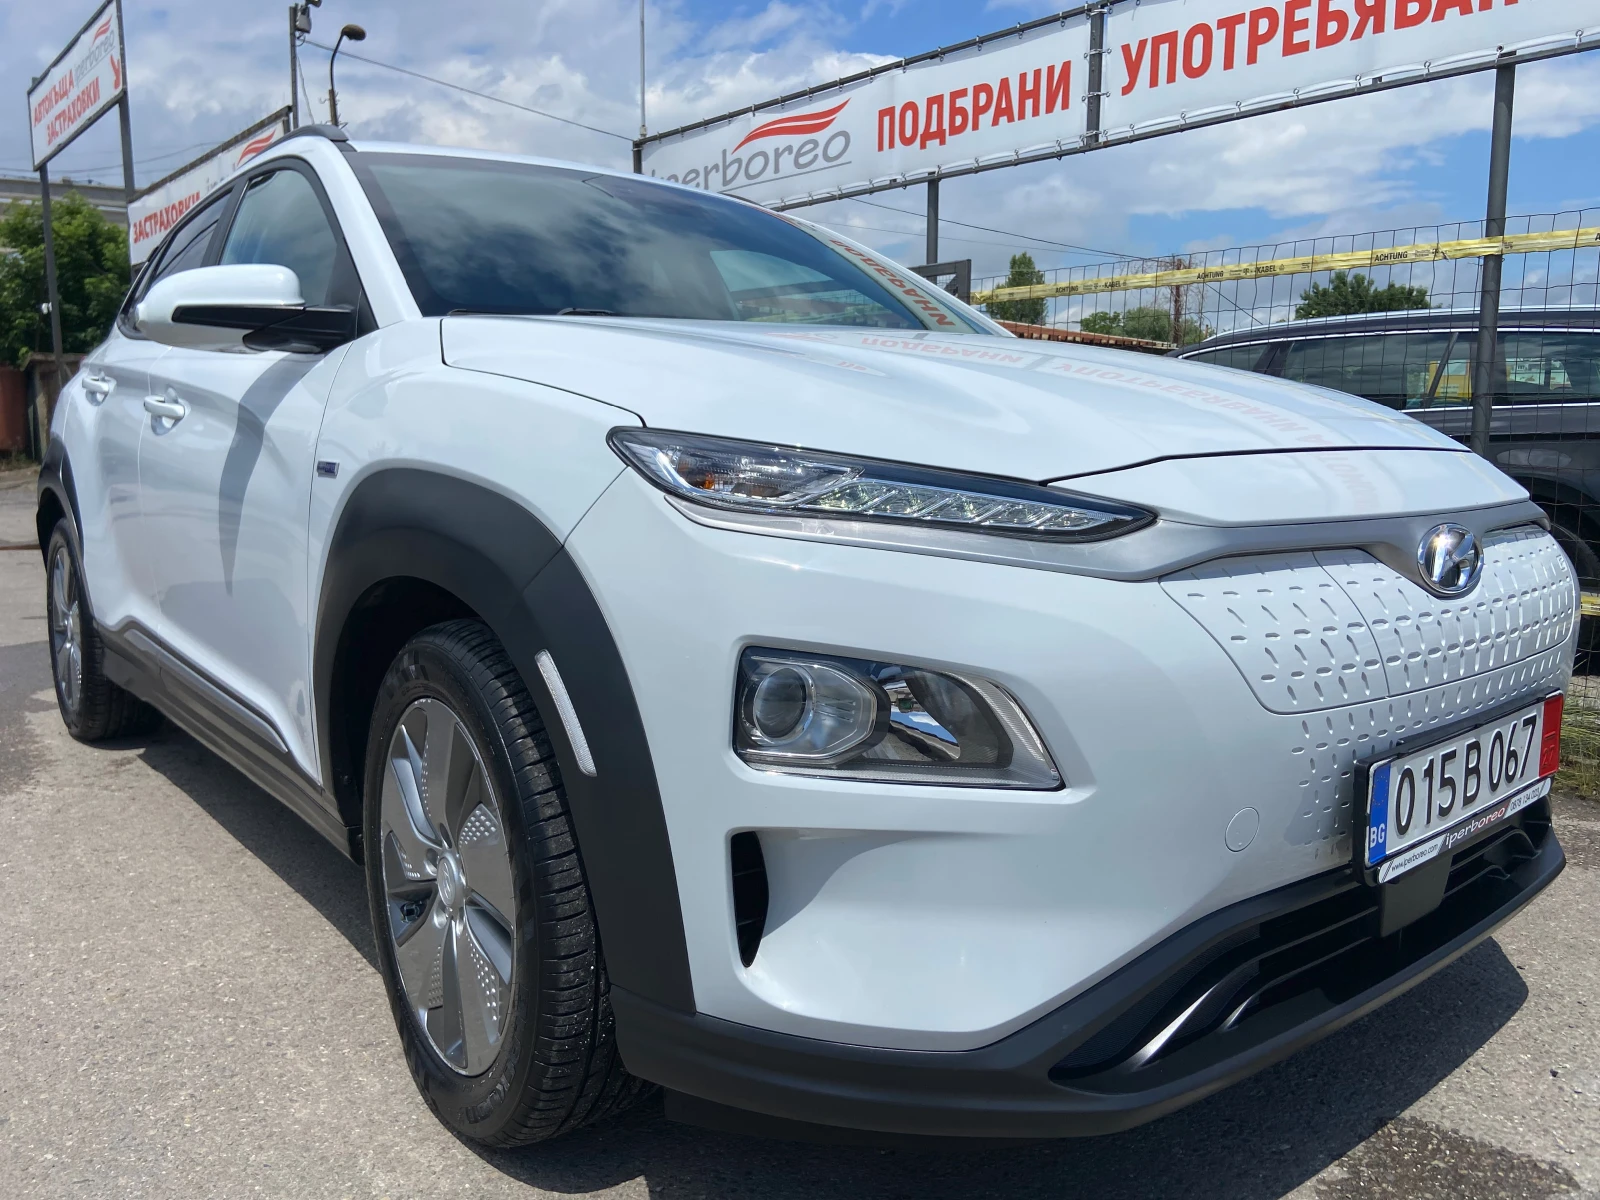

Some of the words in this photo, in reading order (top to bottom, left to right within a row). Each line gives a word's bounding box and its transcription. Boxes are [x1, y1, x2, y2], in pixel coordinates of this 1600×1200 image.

[877, 60, 1071, 152] ПОДБРАНИ
[1121, 0, 1518, 96] УПОТРЕБЯВ
[47, 76, 100, 145] ЗАСТРАХОВКИ
[651, 131, 850, 190] erboreo
[1374, 251, 1408, 262] ACHTUNG
[1055, 285, 1079, 294] ACHTUNG
[1197, 271, 1224, 279] ACHTUNG
[1370, 823, 1385, 848] BG
[1446, 808, 1505, 849] iperboreo
